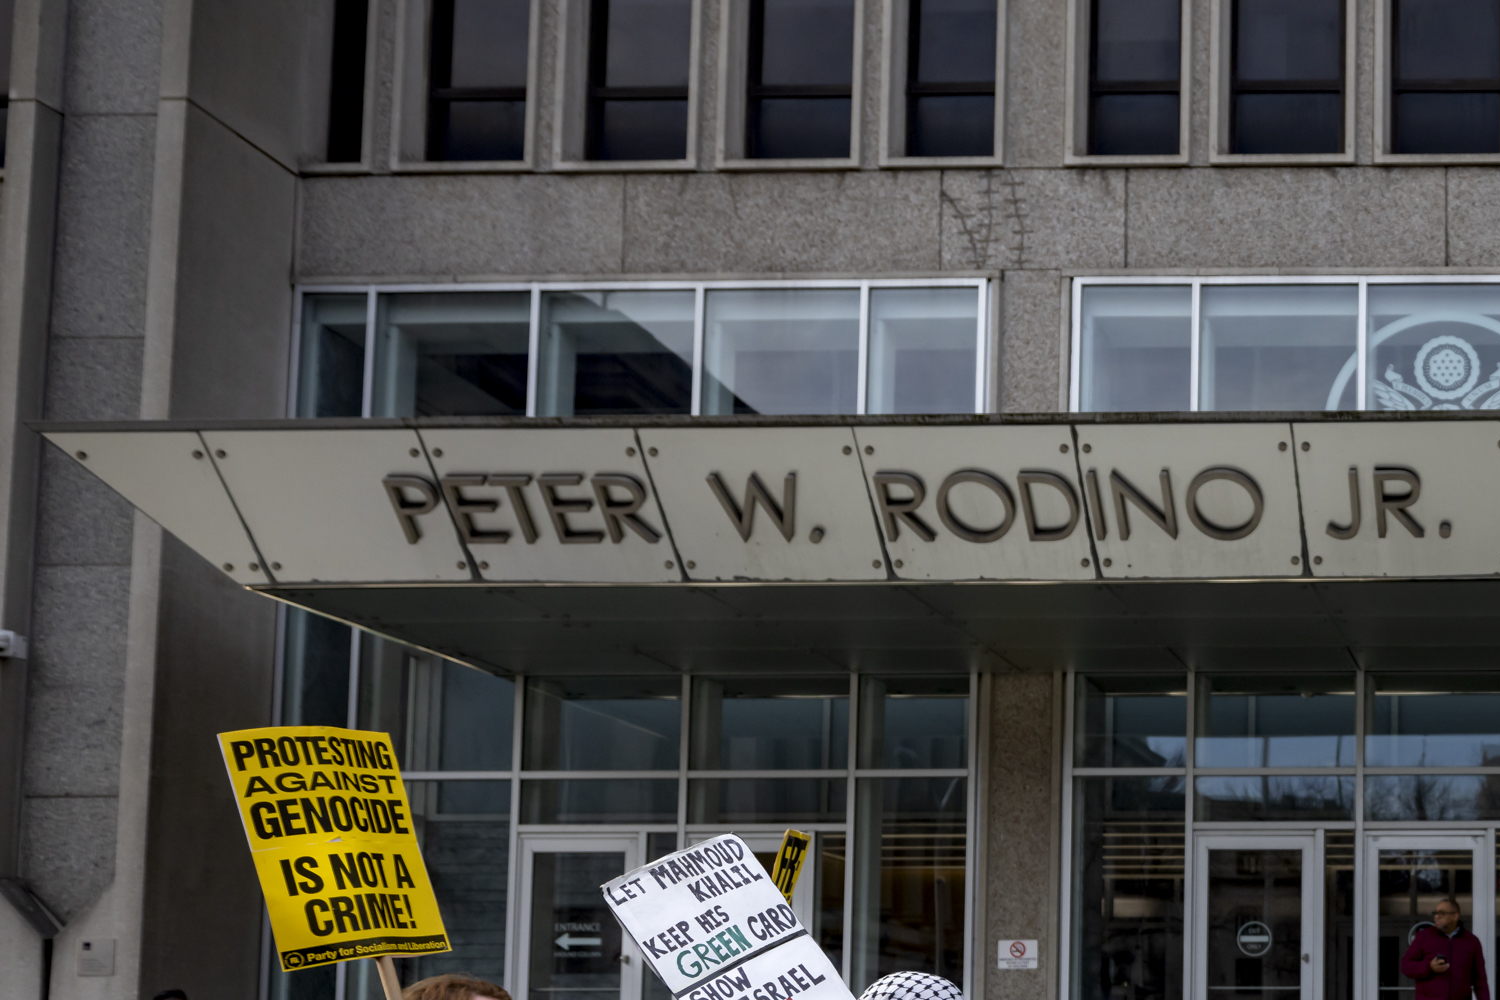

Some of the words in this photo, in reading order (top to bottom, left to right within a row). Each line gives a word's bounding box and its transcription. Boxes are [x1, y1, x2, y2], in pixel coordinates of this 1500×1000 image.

[382, 472, 661, 546] PETER
[706, 471, 825, 544] W.
[874, 466, 1265, 544] RODINO
[1326, 465, 1453, 541] JR.
[231, 735, 393, 772] PROTESTING
[244, 770, 397, 799] AGAINST
[249, 796, 409, 839] GENOCIDE
[280, 855, 323, 898] IS
[331, 851, 389, 891] NOT
[393, 853, 415, 890] A
[606, 877, 646, 906] LET
[648, 838, 745, 891] MAHMOUD
[687, 863, 764, 904] KHALIL
[303, 894, 418, 937] CRIME!
[554, 922, 601, 932] ENTRANCE
[642, 920, 695, 960] KEEP
[694, 904, 730, 934] HIS
[307, 950, 337, 962] Party
[338, 947, 355, 957] for
[355, 942, 397, 954] Socialism
[397, 942, 408, 950] and
[408, 940, 446, 951] Liberation
[676, 924, 753, 979] GREEN
[746, 903, 797, 941] CARD
